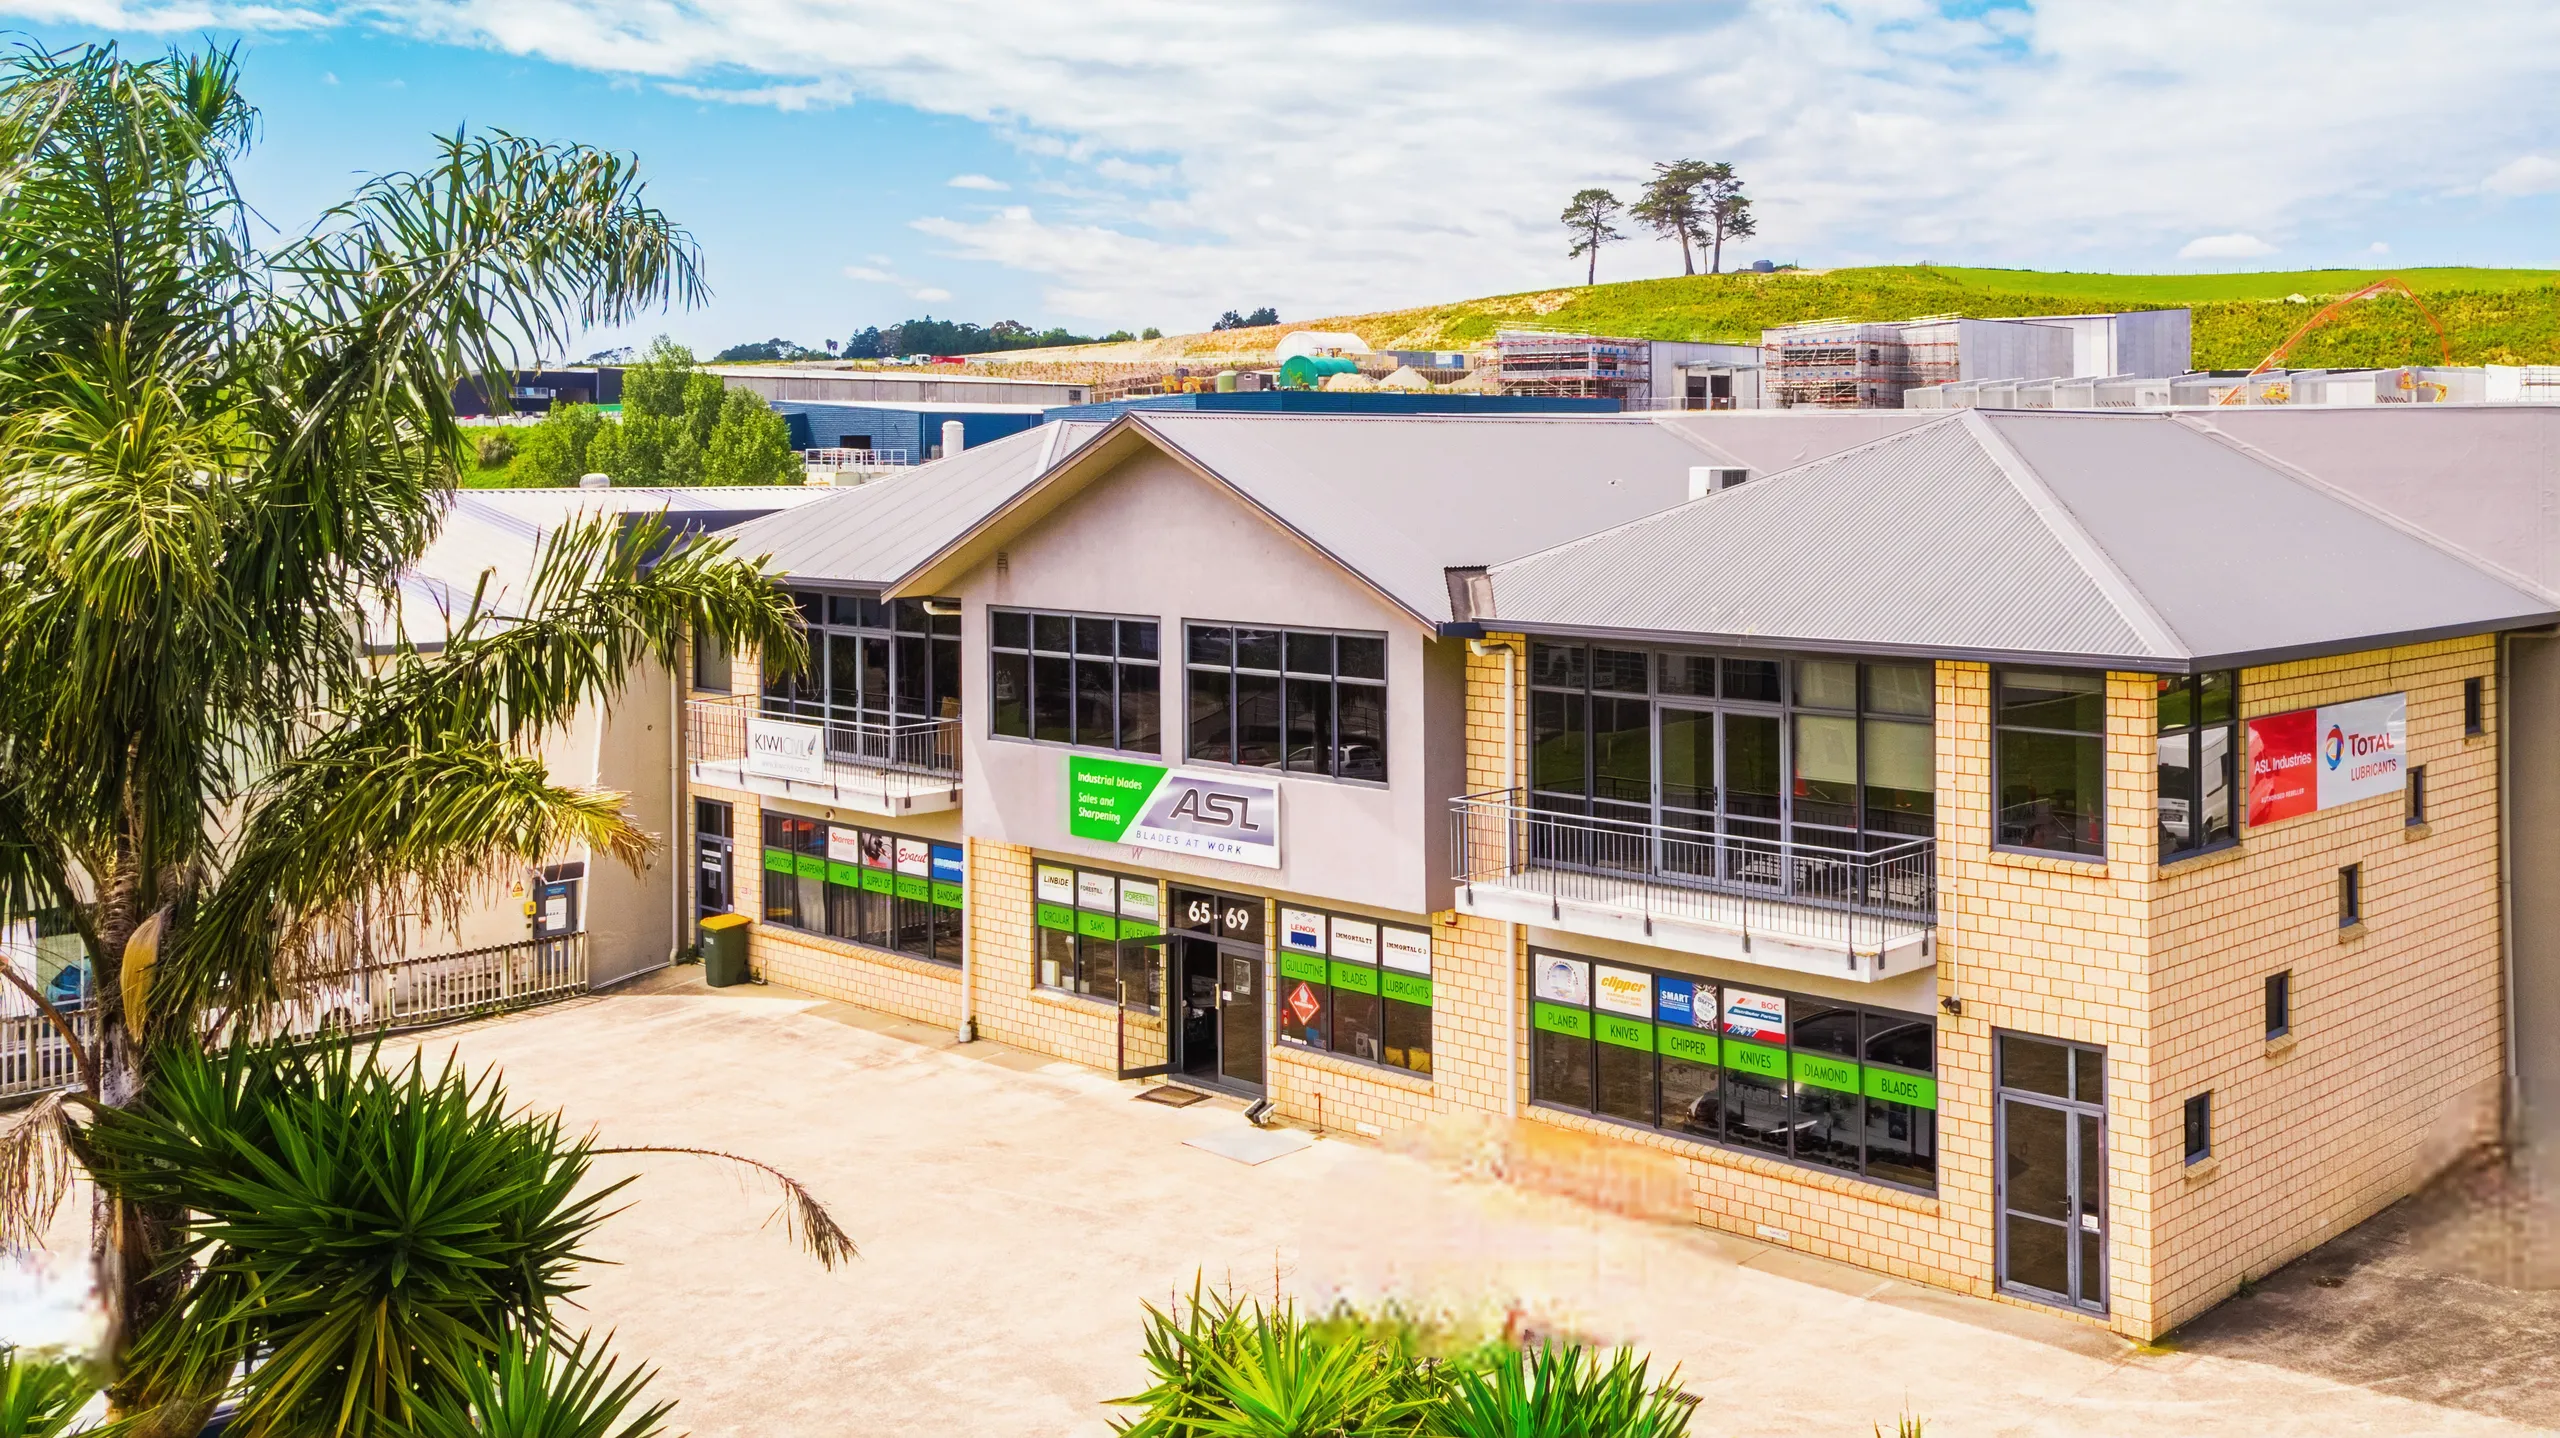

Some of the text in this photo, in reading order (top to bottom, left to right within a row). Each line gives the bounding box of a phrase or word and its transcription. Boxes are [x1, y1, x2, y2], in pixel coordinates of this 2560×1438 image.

[2253, 752, 2313, 776] ASL Industries
[2350, 758, 2397, 782] LUBRICANTS
[1077, 771, 1143, 791] Industrial blades
[1078, 792, 1115, 807] Sales and
[1078, 807, 1121, 826] Sharpening
[1169, 787, 1260, 832] ASL
[1136, 829, 1243, 856] BLADES AT WORK
[839, 870, 851, 881] AND
[866, 875, 891, 889] SUPPLY OF
[898, 881, 918, 896] ROUTER
[936, 888, 963, 904] BANDSAWS
[1043, 910, 1070, 925] CIRCULAR
[1188, 900, 1211, 924] 65
[1225, 907, 1249, 931] 69
[1089, 919, 1106, 933] SAWS
[1290, 923, 1316, 934] LENOX
[1386, 941, 1418, 954] IMMORTAL
[1285, 959, 1324, 978] GUILLOTINE
[1341, 969, 1368, 987] BLADES
[1385, 978, 1430, 999] LUBRICANTS
[1600, 975, 1647, 993] clipper
[1661, 989, 1690, 1004] SMART
[1760, 1001, 1781, 1012] BOC
[1547, 1011, 1579, 1030] PLANER
[1609, 1023, 1640, 1042] KNIVES
[1670, 1036, 1707, 1057] CHIPPER
[1739, 1049, 1772, 1070] KNIVES
[1803, 1062, 1849, 1085] DIAMOND
[1881, 1077, 1919, 1099] BLADES
